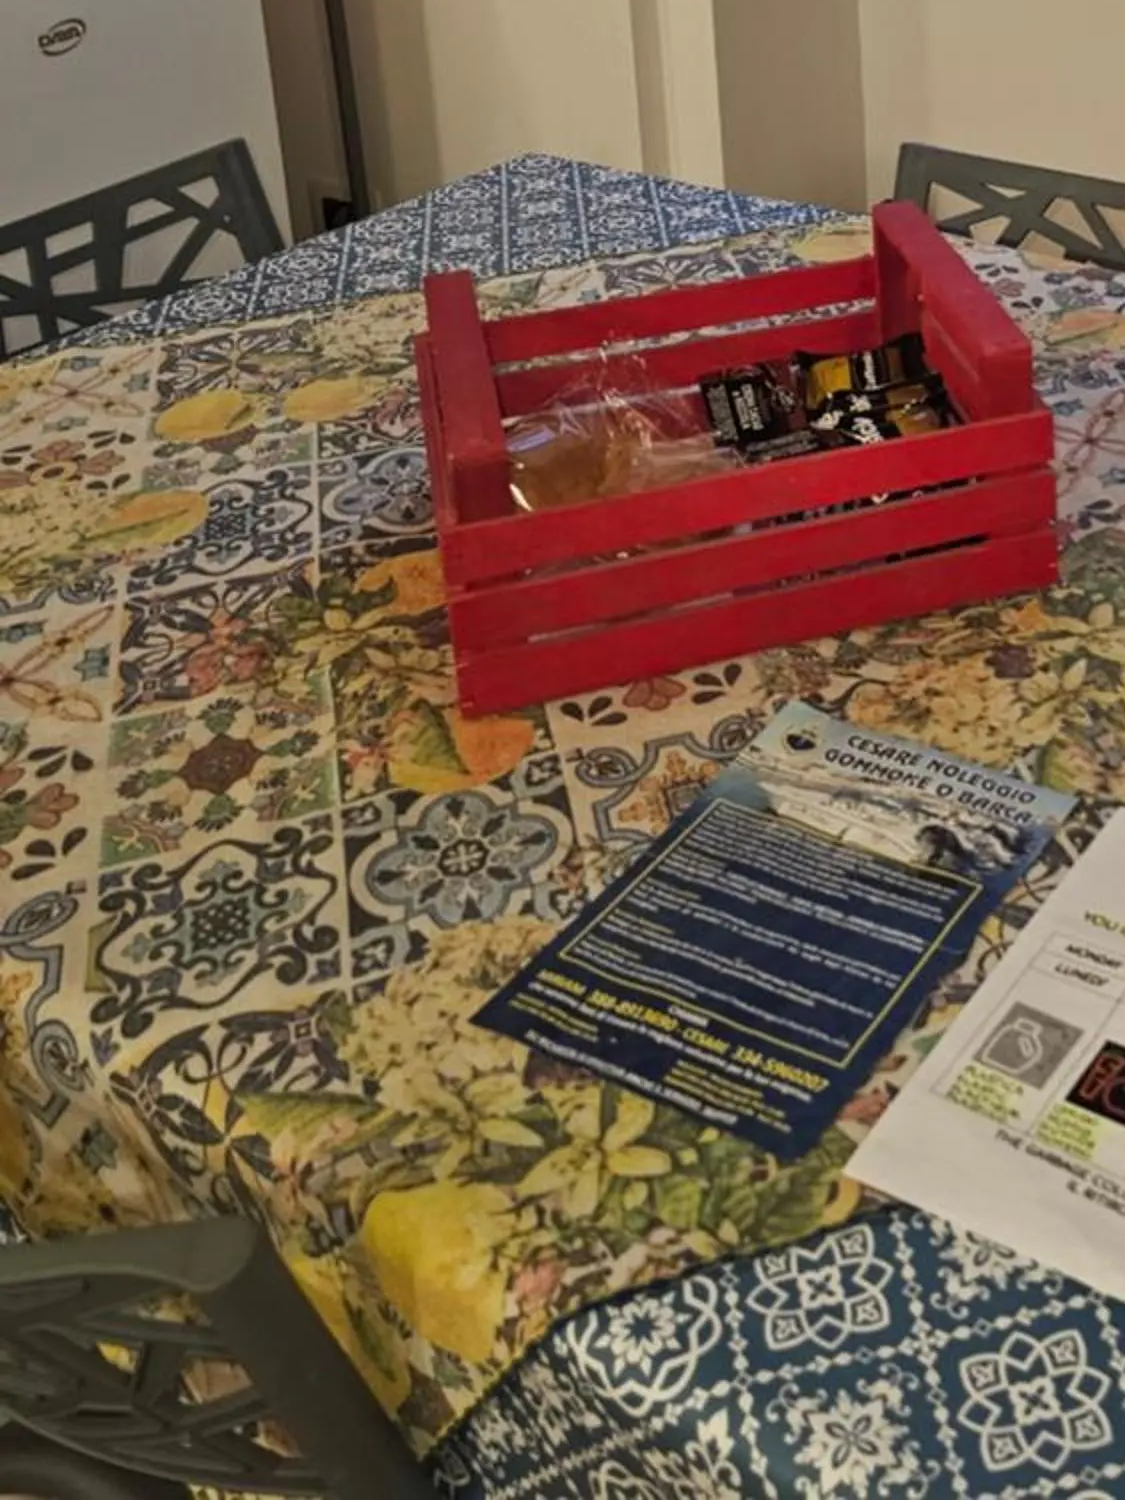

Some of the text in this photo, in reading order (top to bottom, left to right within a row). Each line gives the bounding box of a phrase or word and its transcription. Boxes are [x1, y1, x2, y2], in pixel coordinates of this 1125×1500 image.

[847, 735, 1035, 803] CESARE NOLEGGIO
[957, 790, 1032, 823] BARCA
[1084, 911, 1118, 931] YOU
